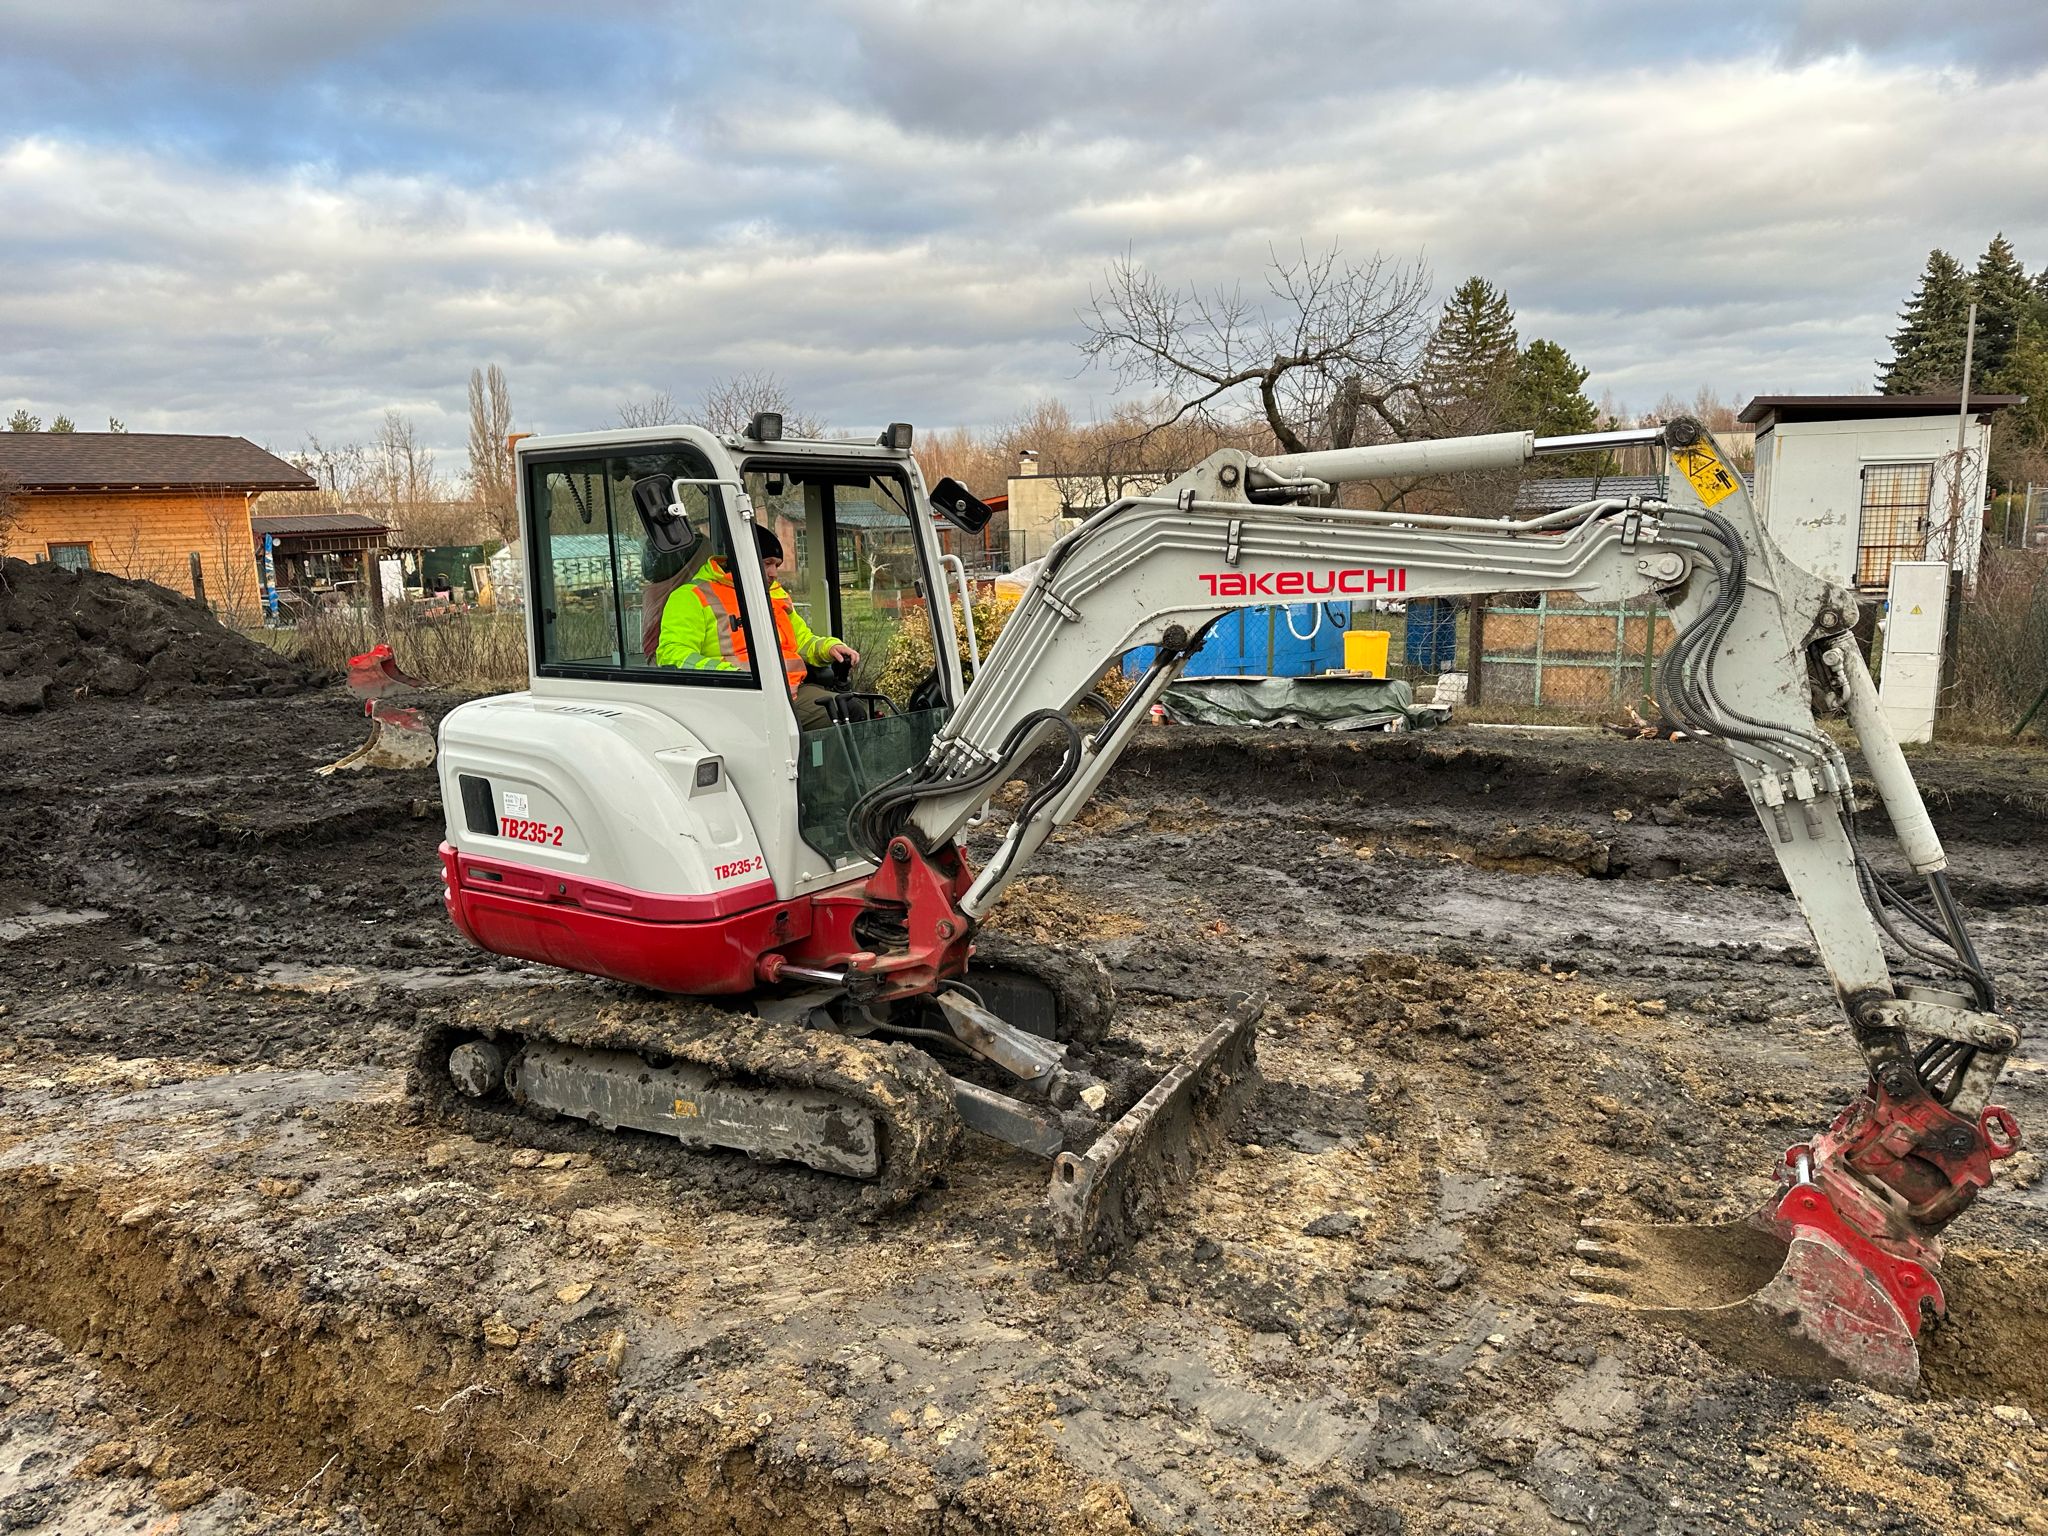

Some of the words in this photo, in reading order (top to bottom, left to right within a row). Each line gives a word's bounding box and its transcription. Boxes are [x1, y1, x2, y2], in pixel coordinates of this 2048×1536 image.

[1199, 569, 1406, 596] TAKEUCHI
[501, 817, 563, 846] TB235-2
[714, 856, 763, 880] TB235-2
